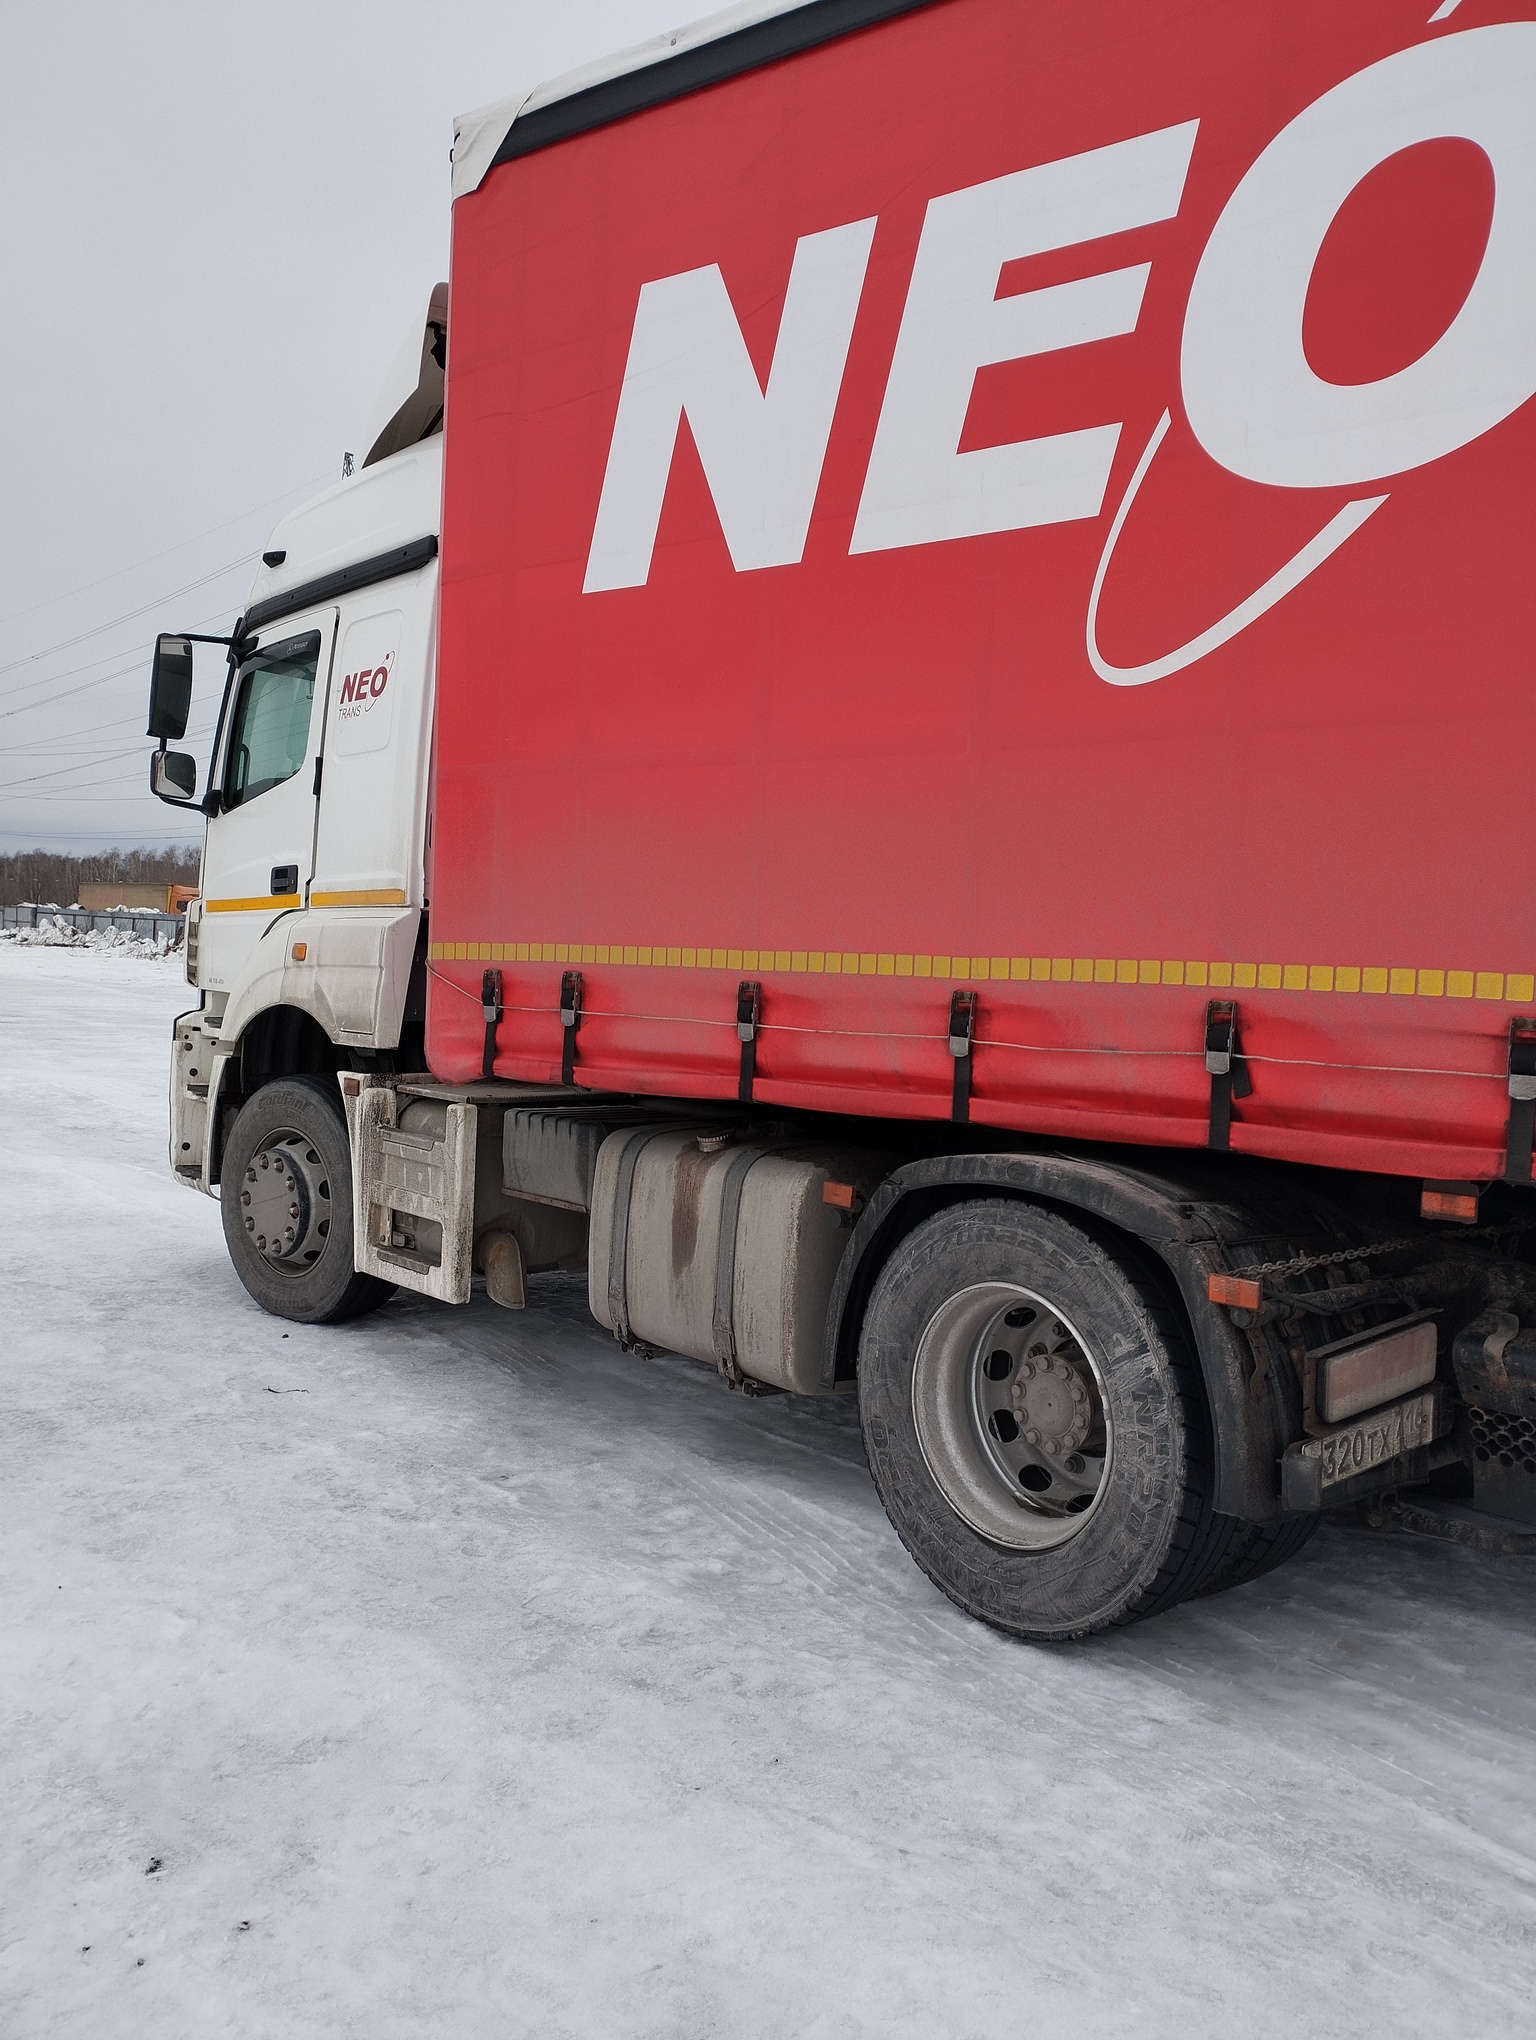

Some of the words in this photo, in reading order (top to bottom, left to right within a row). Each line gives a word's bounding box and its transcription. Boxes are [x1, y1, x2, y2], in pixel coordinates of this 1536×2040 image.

[582, 20, 1536, 594] NEO
[340, 666, 388, 704] NEO
[338, 705, 362, 720] TRANS
